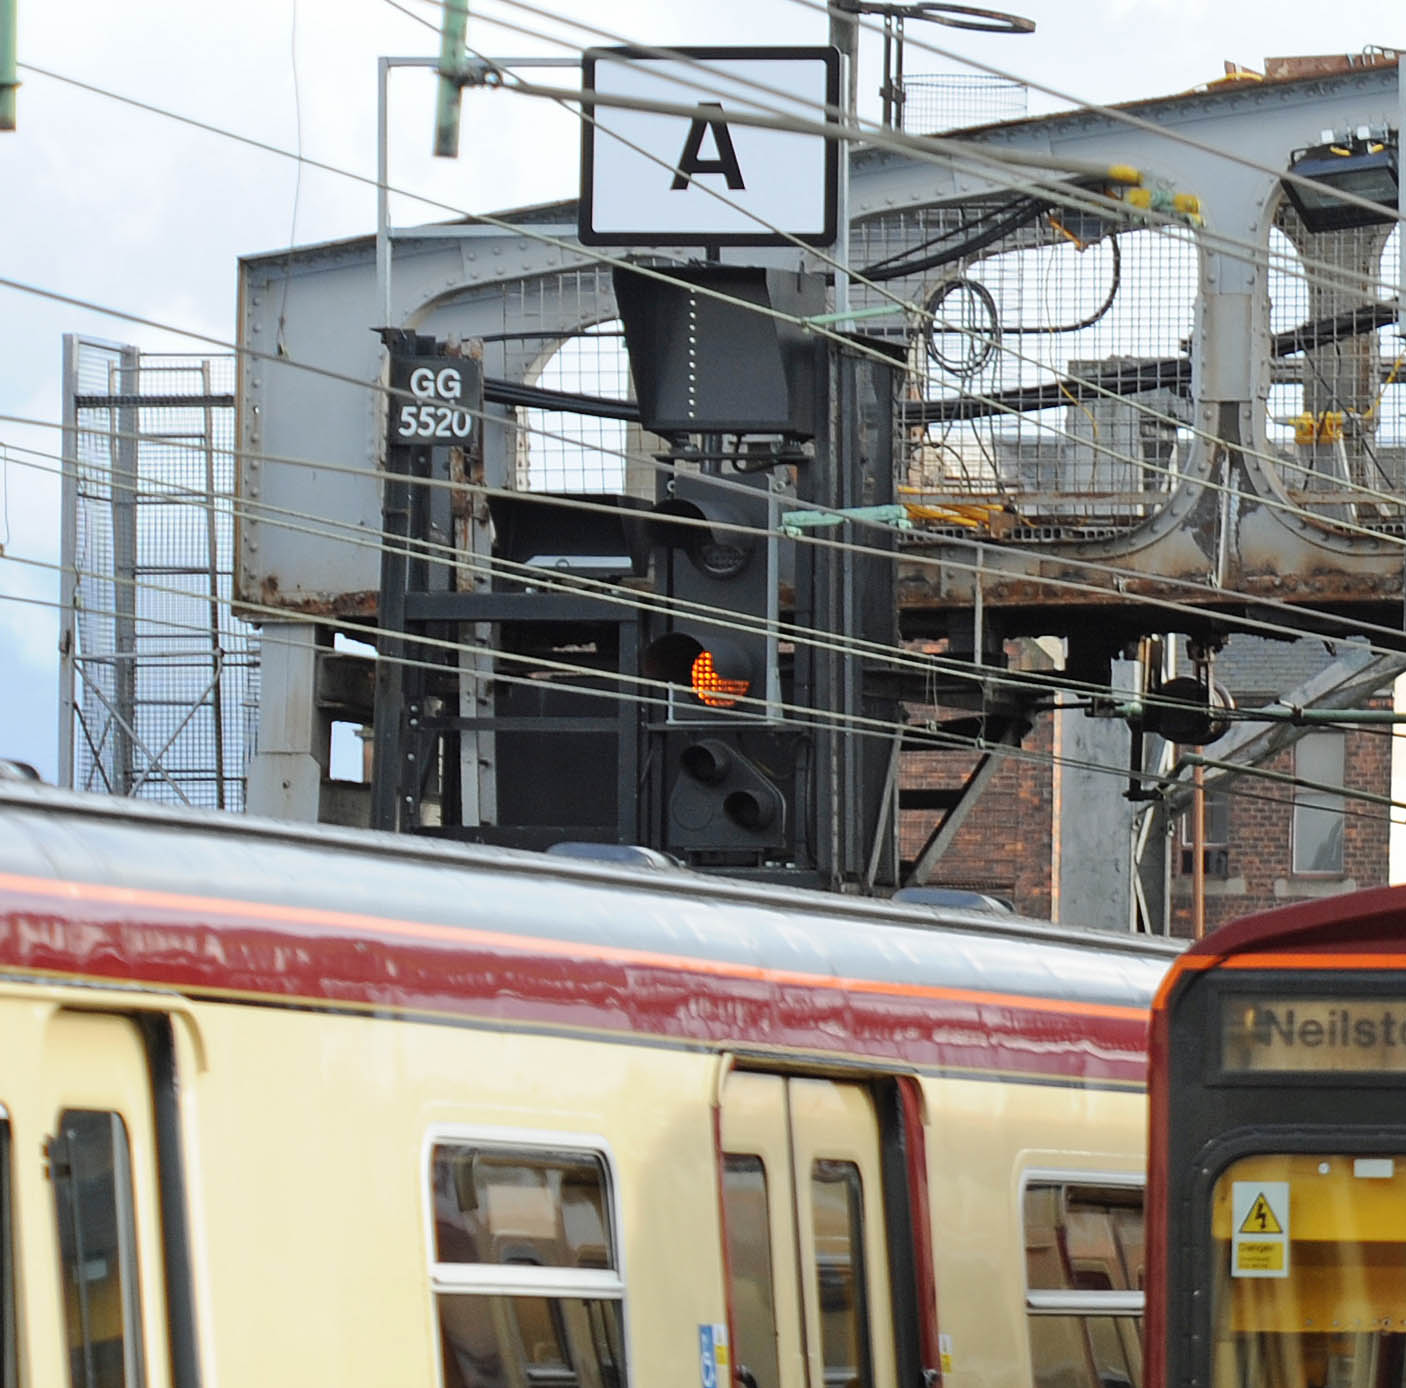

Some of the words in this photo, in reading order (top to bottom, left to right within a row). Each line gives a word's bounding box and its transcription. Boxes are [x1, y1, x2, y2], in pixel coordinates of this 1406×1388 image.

[671, 103, 746, 190] A
[410, 368, 461, 399] GG
[399, 406, 472, 437] 5520
